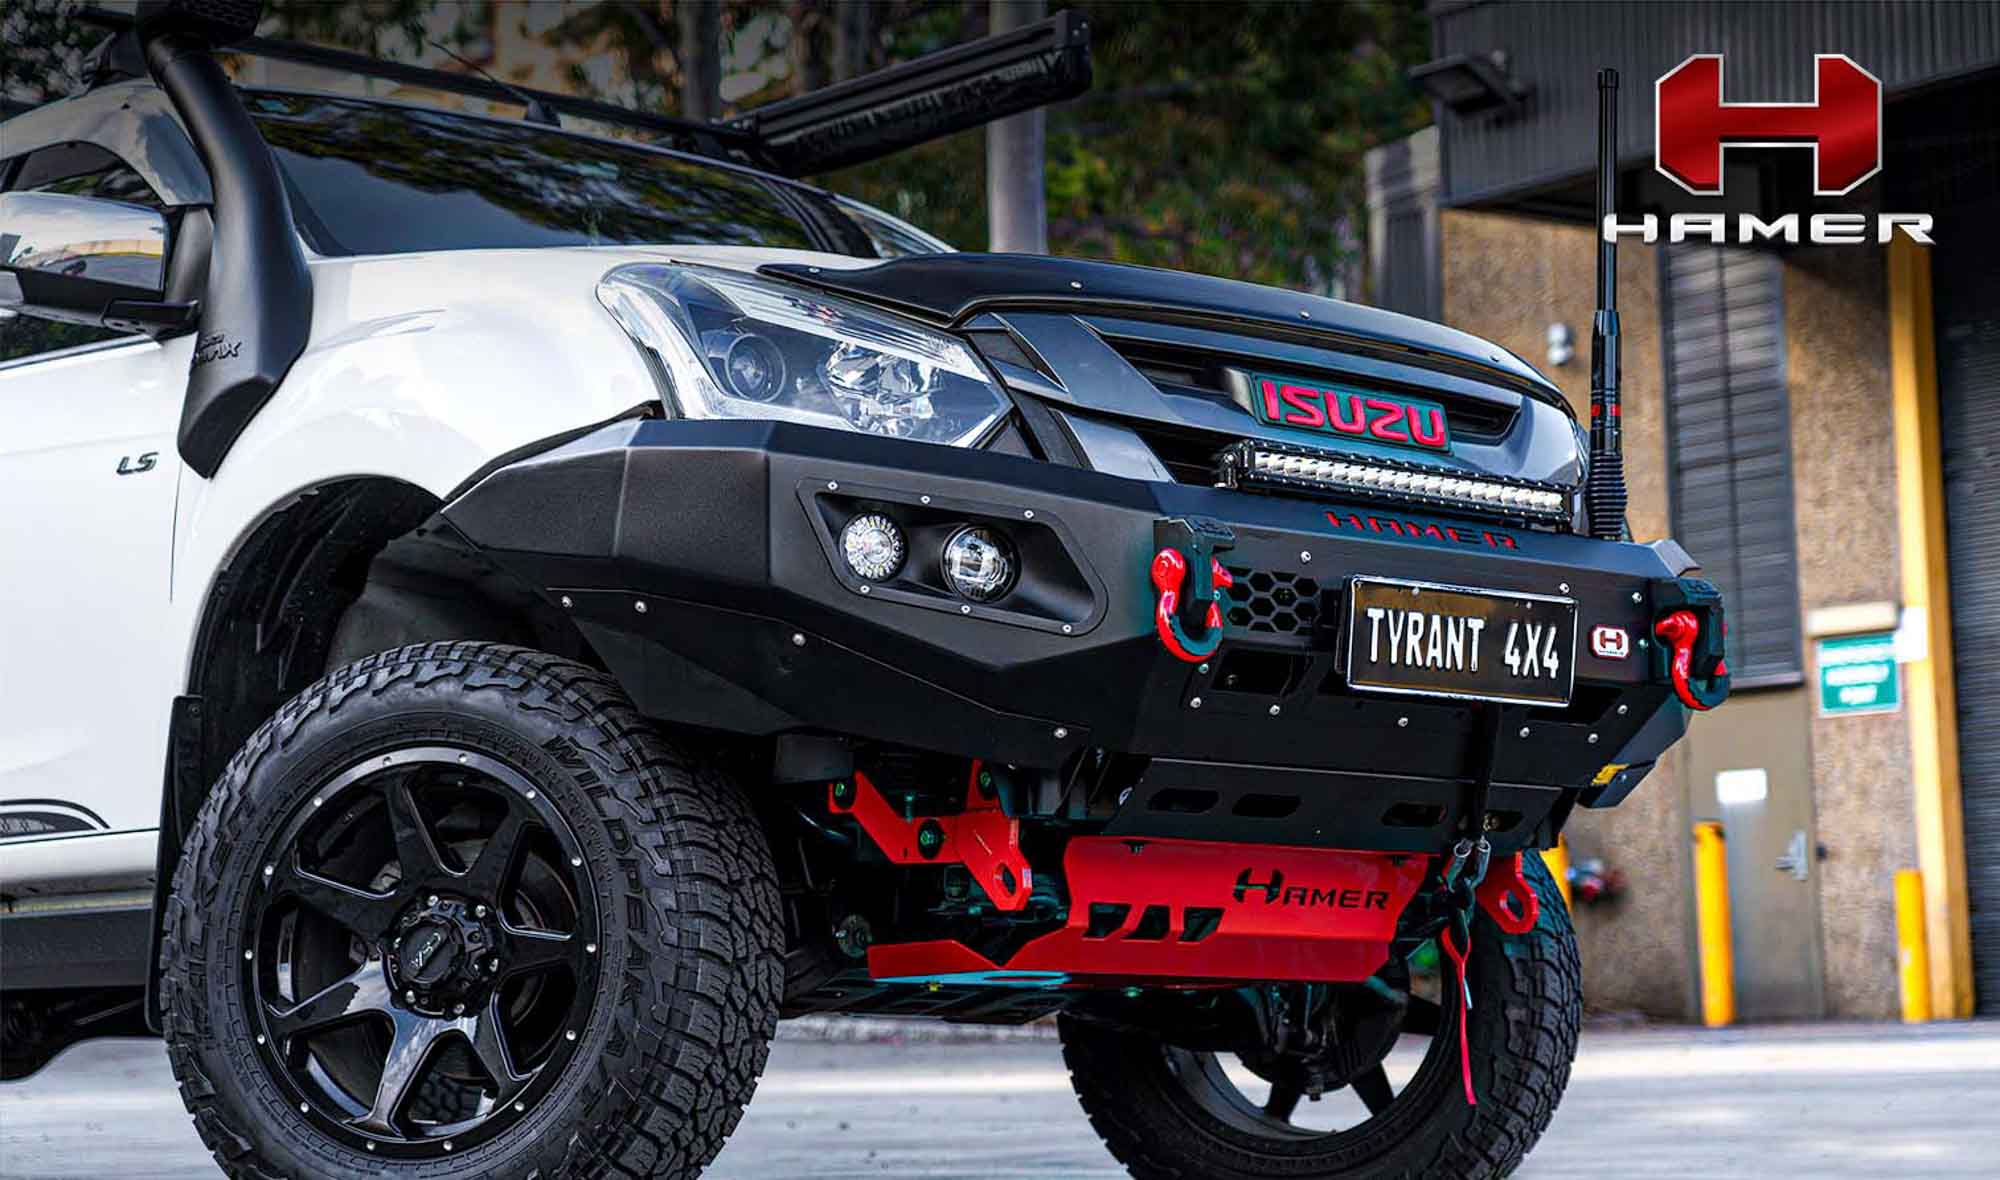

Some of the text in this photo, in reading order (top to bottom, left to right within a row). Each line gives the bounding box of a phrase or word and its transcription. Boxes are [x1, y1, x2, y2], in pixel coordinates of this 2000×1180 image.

[1262, 379, 1446, 447] ISUZU
[116, 451, 159, 475] LS
[1325, 511, 1520, 550] HAMER
[1367, 608, 1560, 680] TYRANT 4X4
[1232, 866, 1389, 910] HAMER
